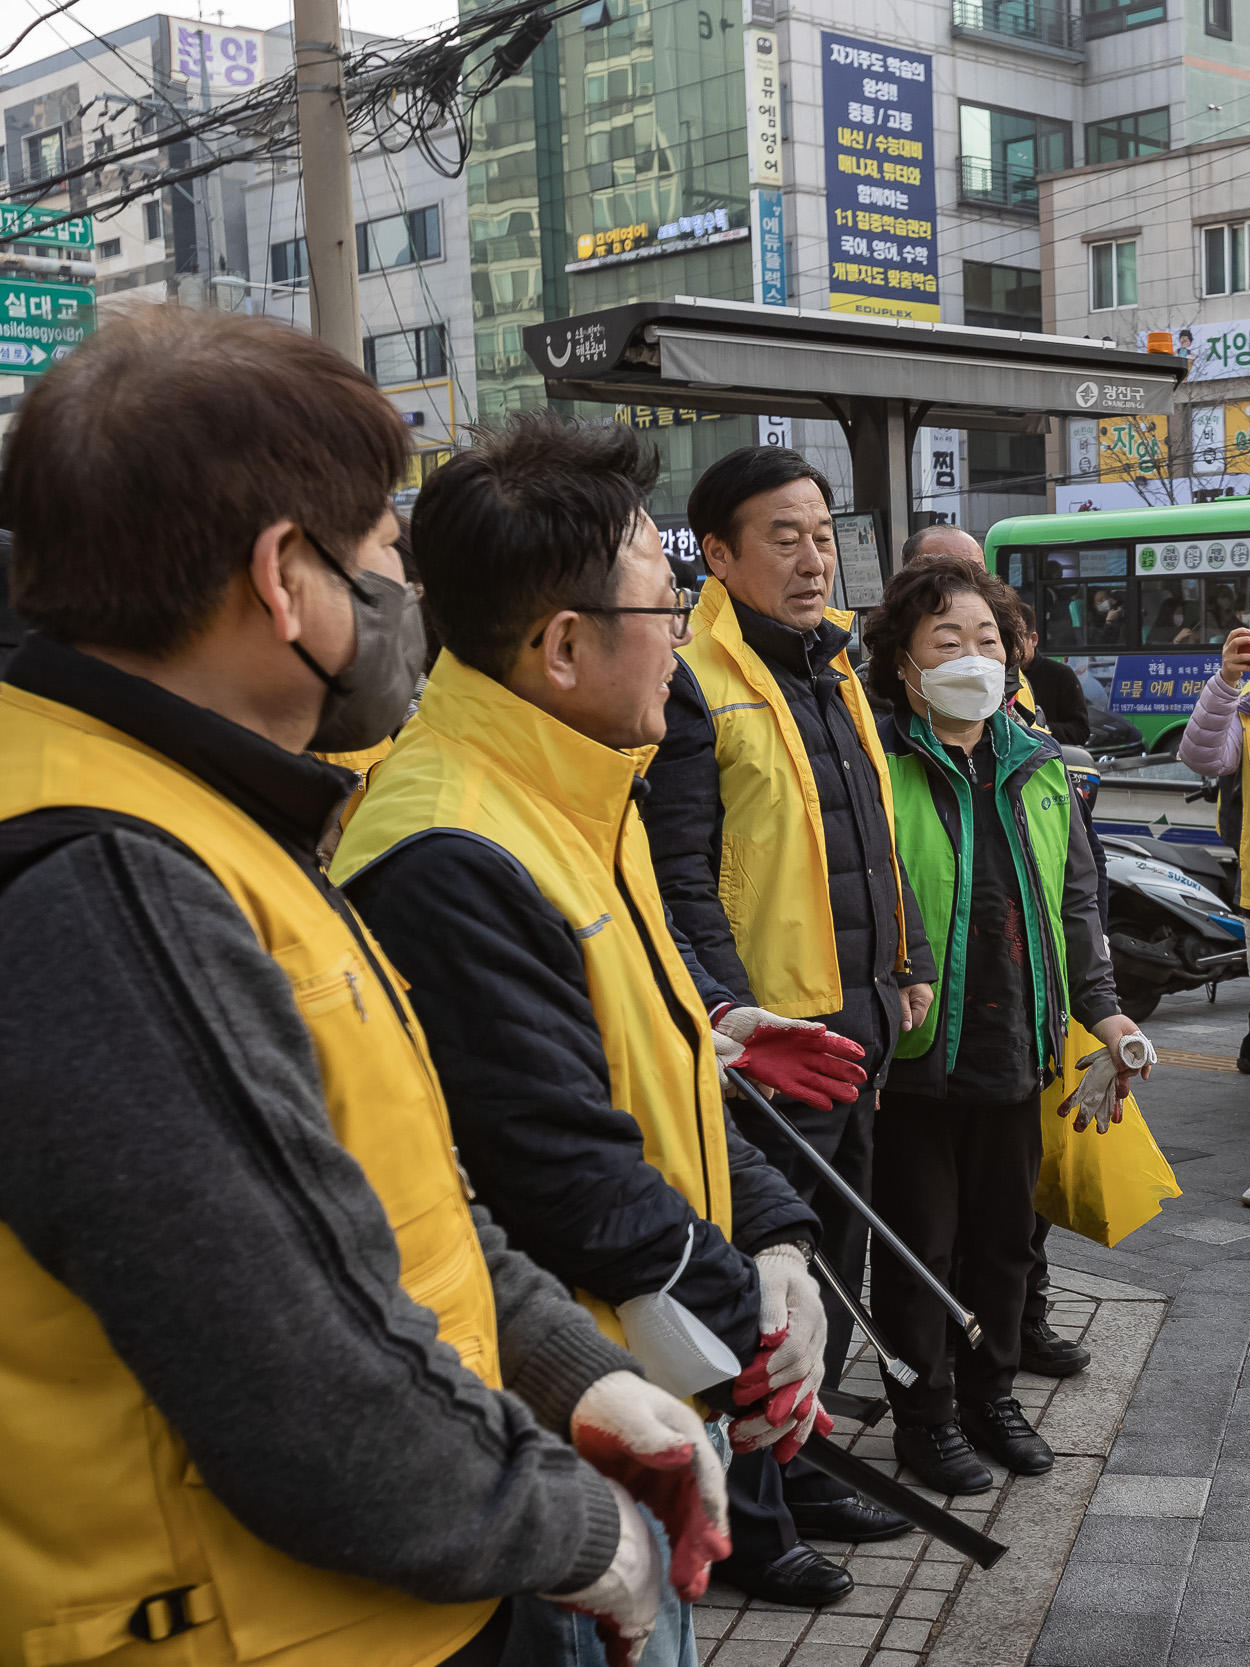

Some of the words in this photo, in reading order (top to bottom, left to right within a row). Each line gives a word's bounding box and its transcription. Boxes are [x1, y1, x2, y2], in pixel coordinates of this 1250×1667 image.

[178, 26, 257, 86] 분양
[830, 43, 885, 73] 자기주도
[886, 56, 926, 82] 학습의
[847, 101, 875, 125] 중등
[886, 109, 913, 132] 고등
[837, 126, 865, 150] 내신
[875, 134, 923, 161] 수능대비
[882, 161, 921, 187] 튜터와
[856, 183, 909, 211] 함께하는
[0, 210, 86, 243] 자초교입구
[833, 207, 854, 228] 1:1
[855, 210, 933, 241] 집중학습관리
[594, 222, 649, 258] 뮤엠영어
[761, 216, 783, 304] 에듀플렉스
[902, 244, 929, 266] 수학
[831, 261, 886, 286] 개별지도
[855, 304, 913, 319] EDUPLEX
[0, 320, 84, 344] sildaegyo(Br)
[1103, 384, 1146, 401] 광진구
[614, 405, 721, 428] 에듀플
[1111, 423, 1160, 474] 자양
[1119, 680, 1144, 698] 무릎
[1150, 680, 1174, 697] 어깨
[1167, 871, 1202, 892] SUZUKI
